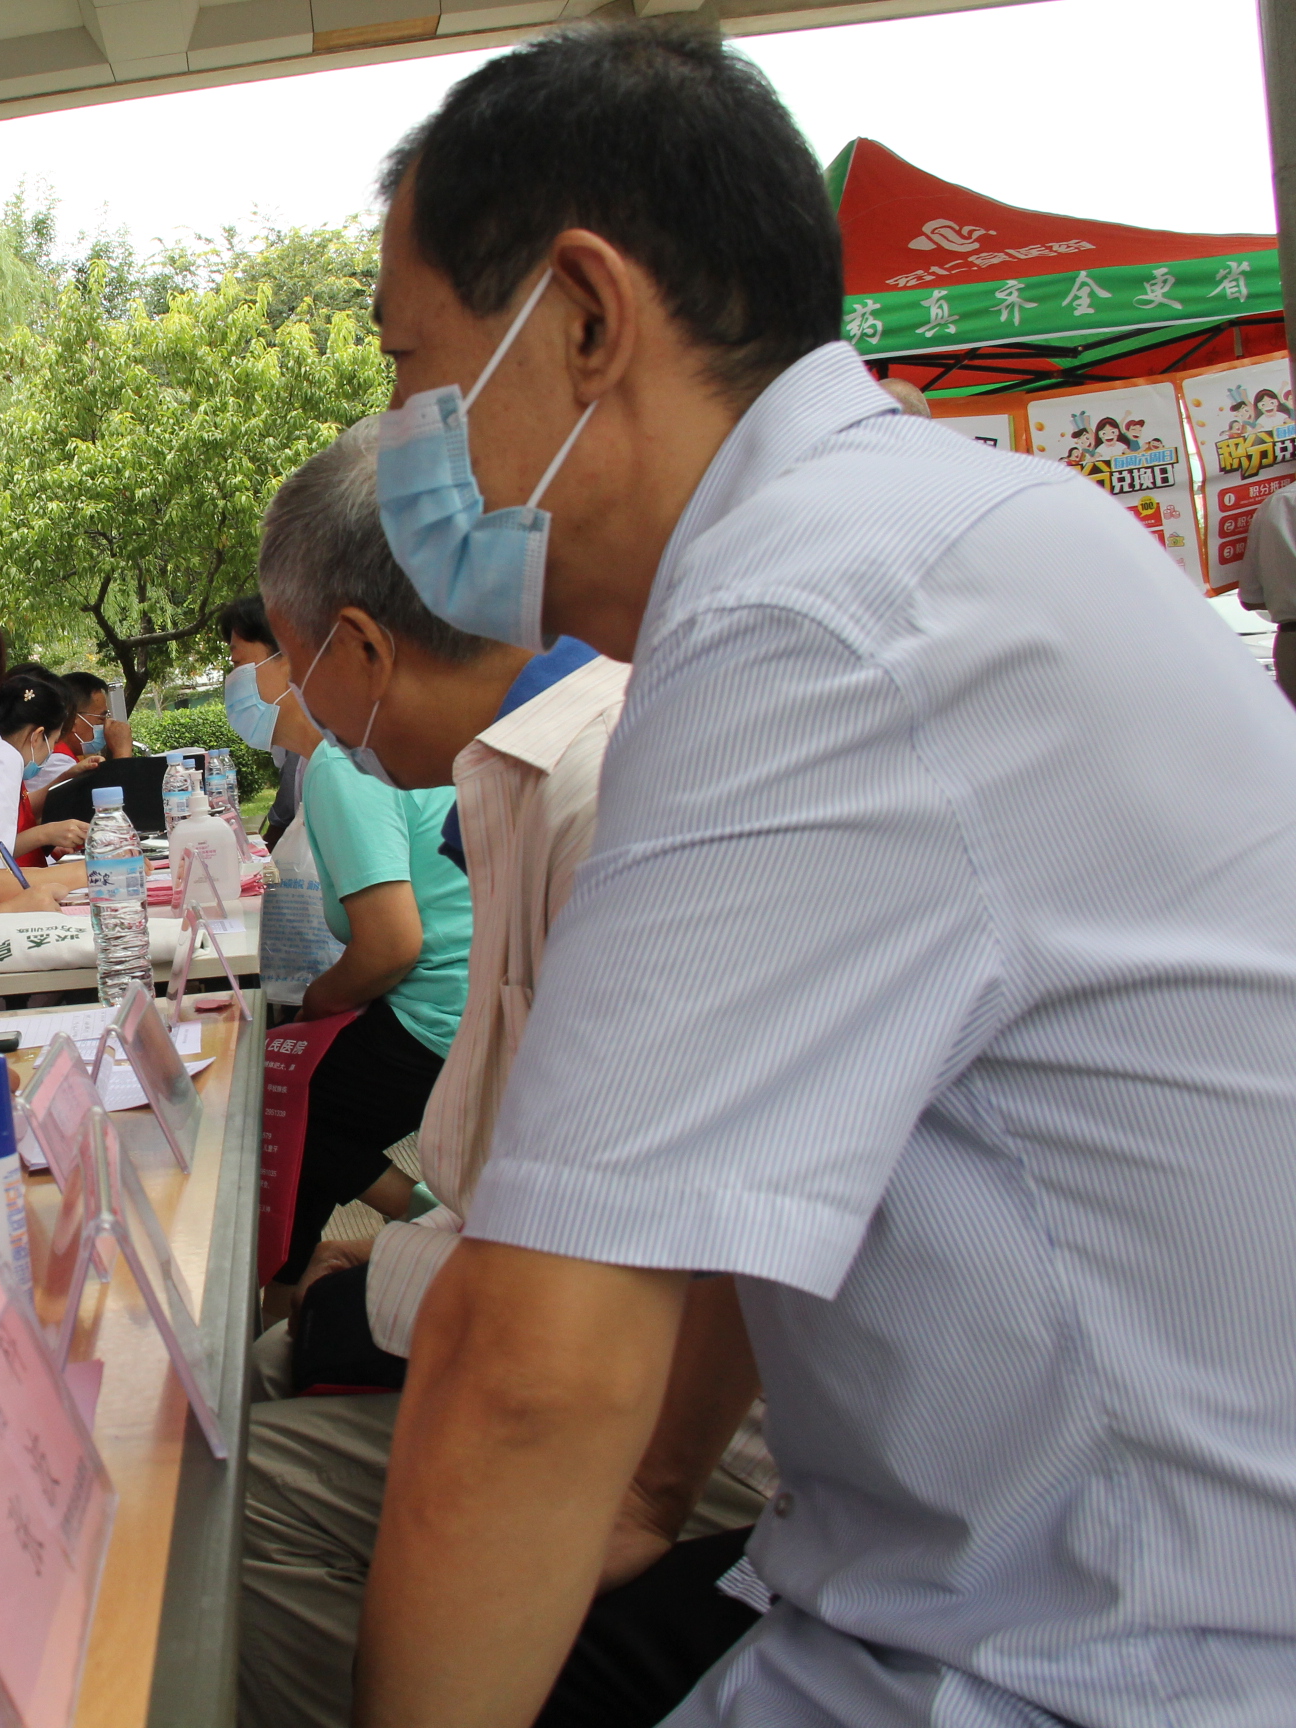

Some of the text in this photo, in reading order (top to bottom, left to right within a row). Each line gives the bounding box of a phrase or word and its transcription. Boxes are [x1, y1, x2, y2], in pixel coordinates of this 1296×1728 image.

[16, 925, 87, 934] 全方位训练
